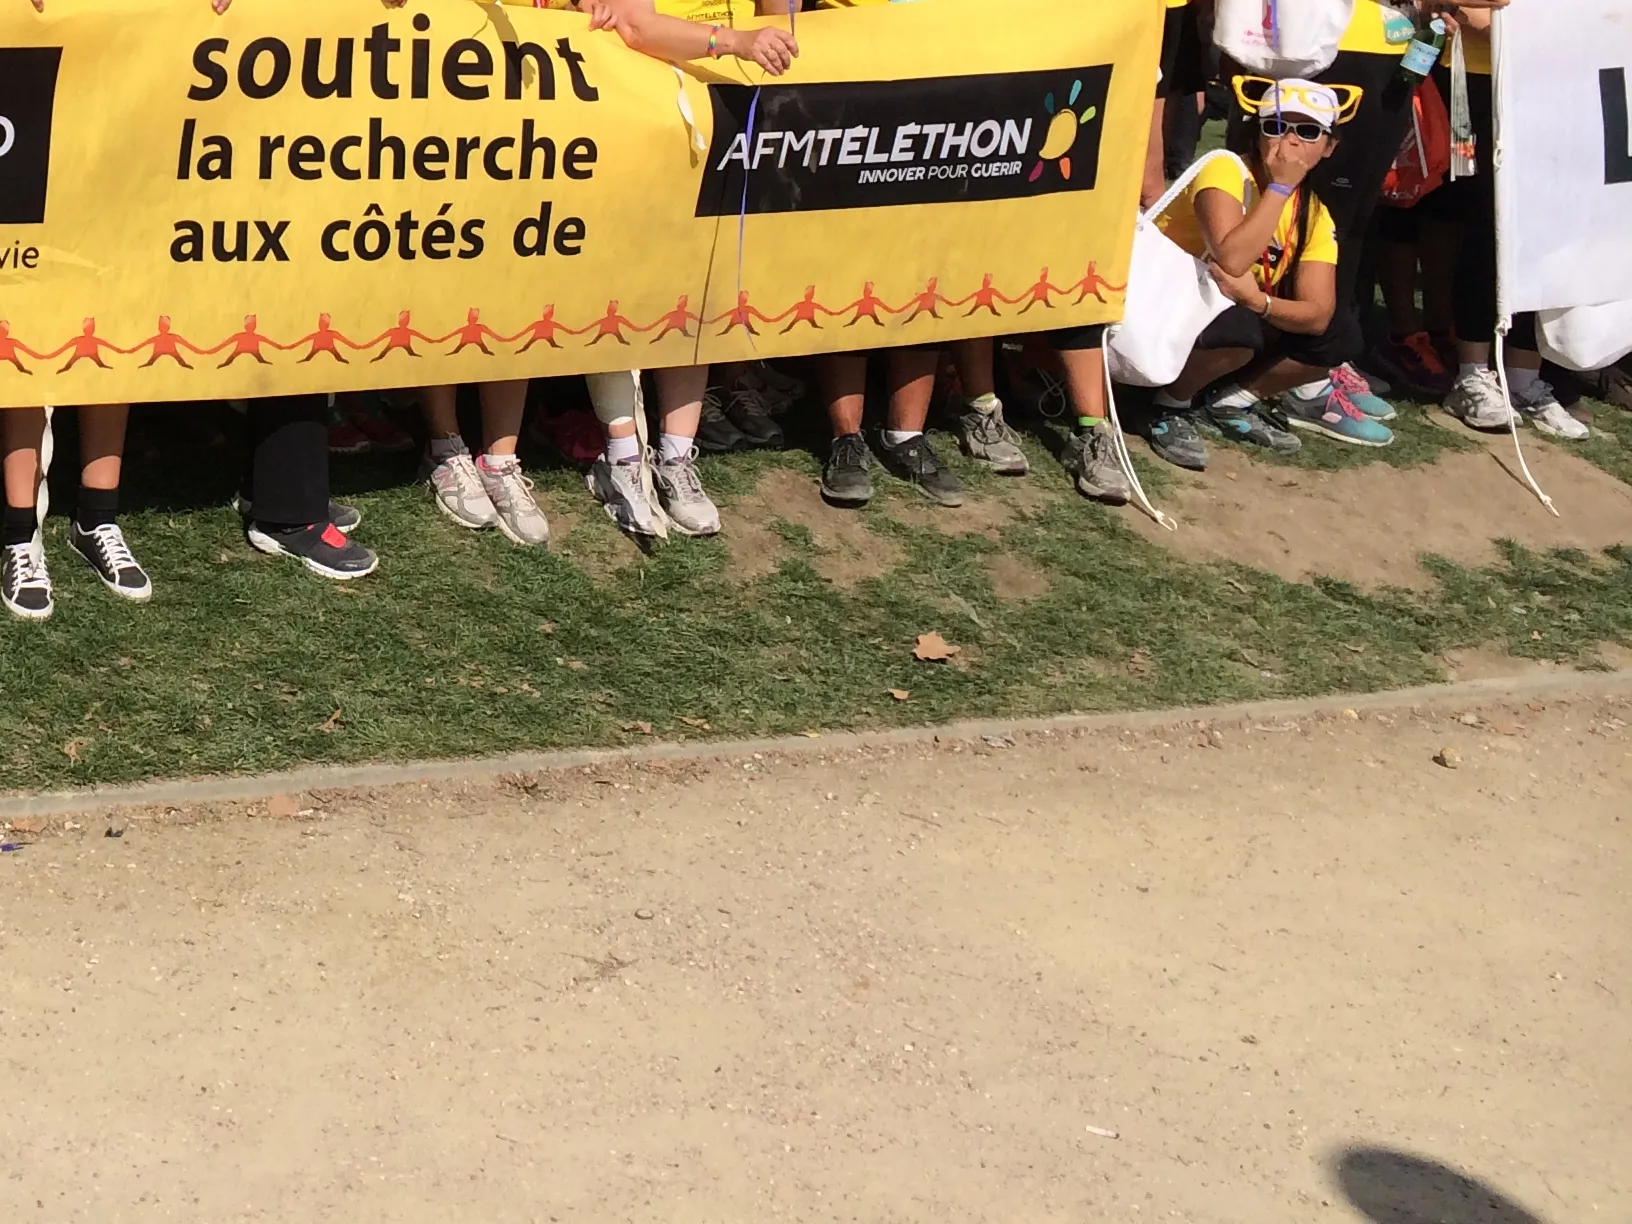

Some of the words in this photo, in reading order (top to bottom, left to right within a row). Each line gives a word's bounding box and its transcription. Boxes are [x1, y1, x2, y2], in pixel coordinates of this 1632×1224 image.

[186, 13, 600, 102] soutient
[176, 118, 234, 181] la
[259, 117, 599, 181] recherche
[858, 166, 927, 184] INNOVER
[927, 163, 970, 180] POUR
[970, 161, 1023, 178] GUÉRIR
[169, 219, 291, 263] aux
[320, 203, 486, 261] côtés
[513, 201, 586, 257] de
